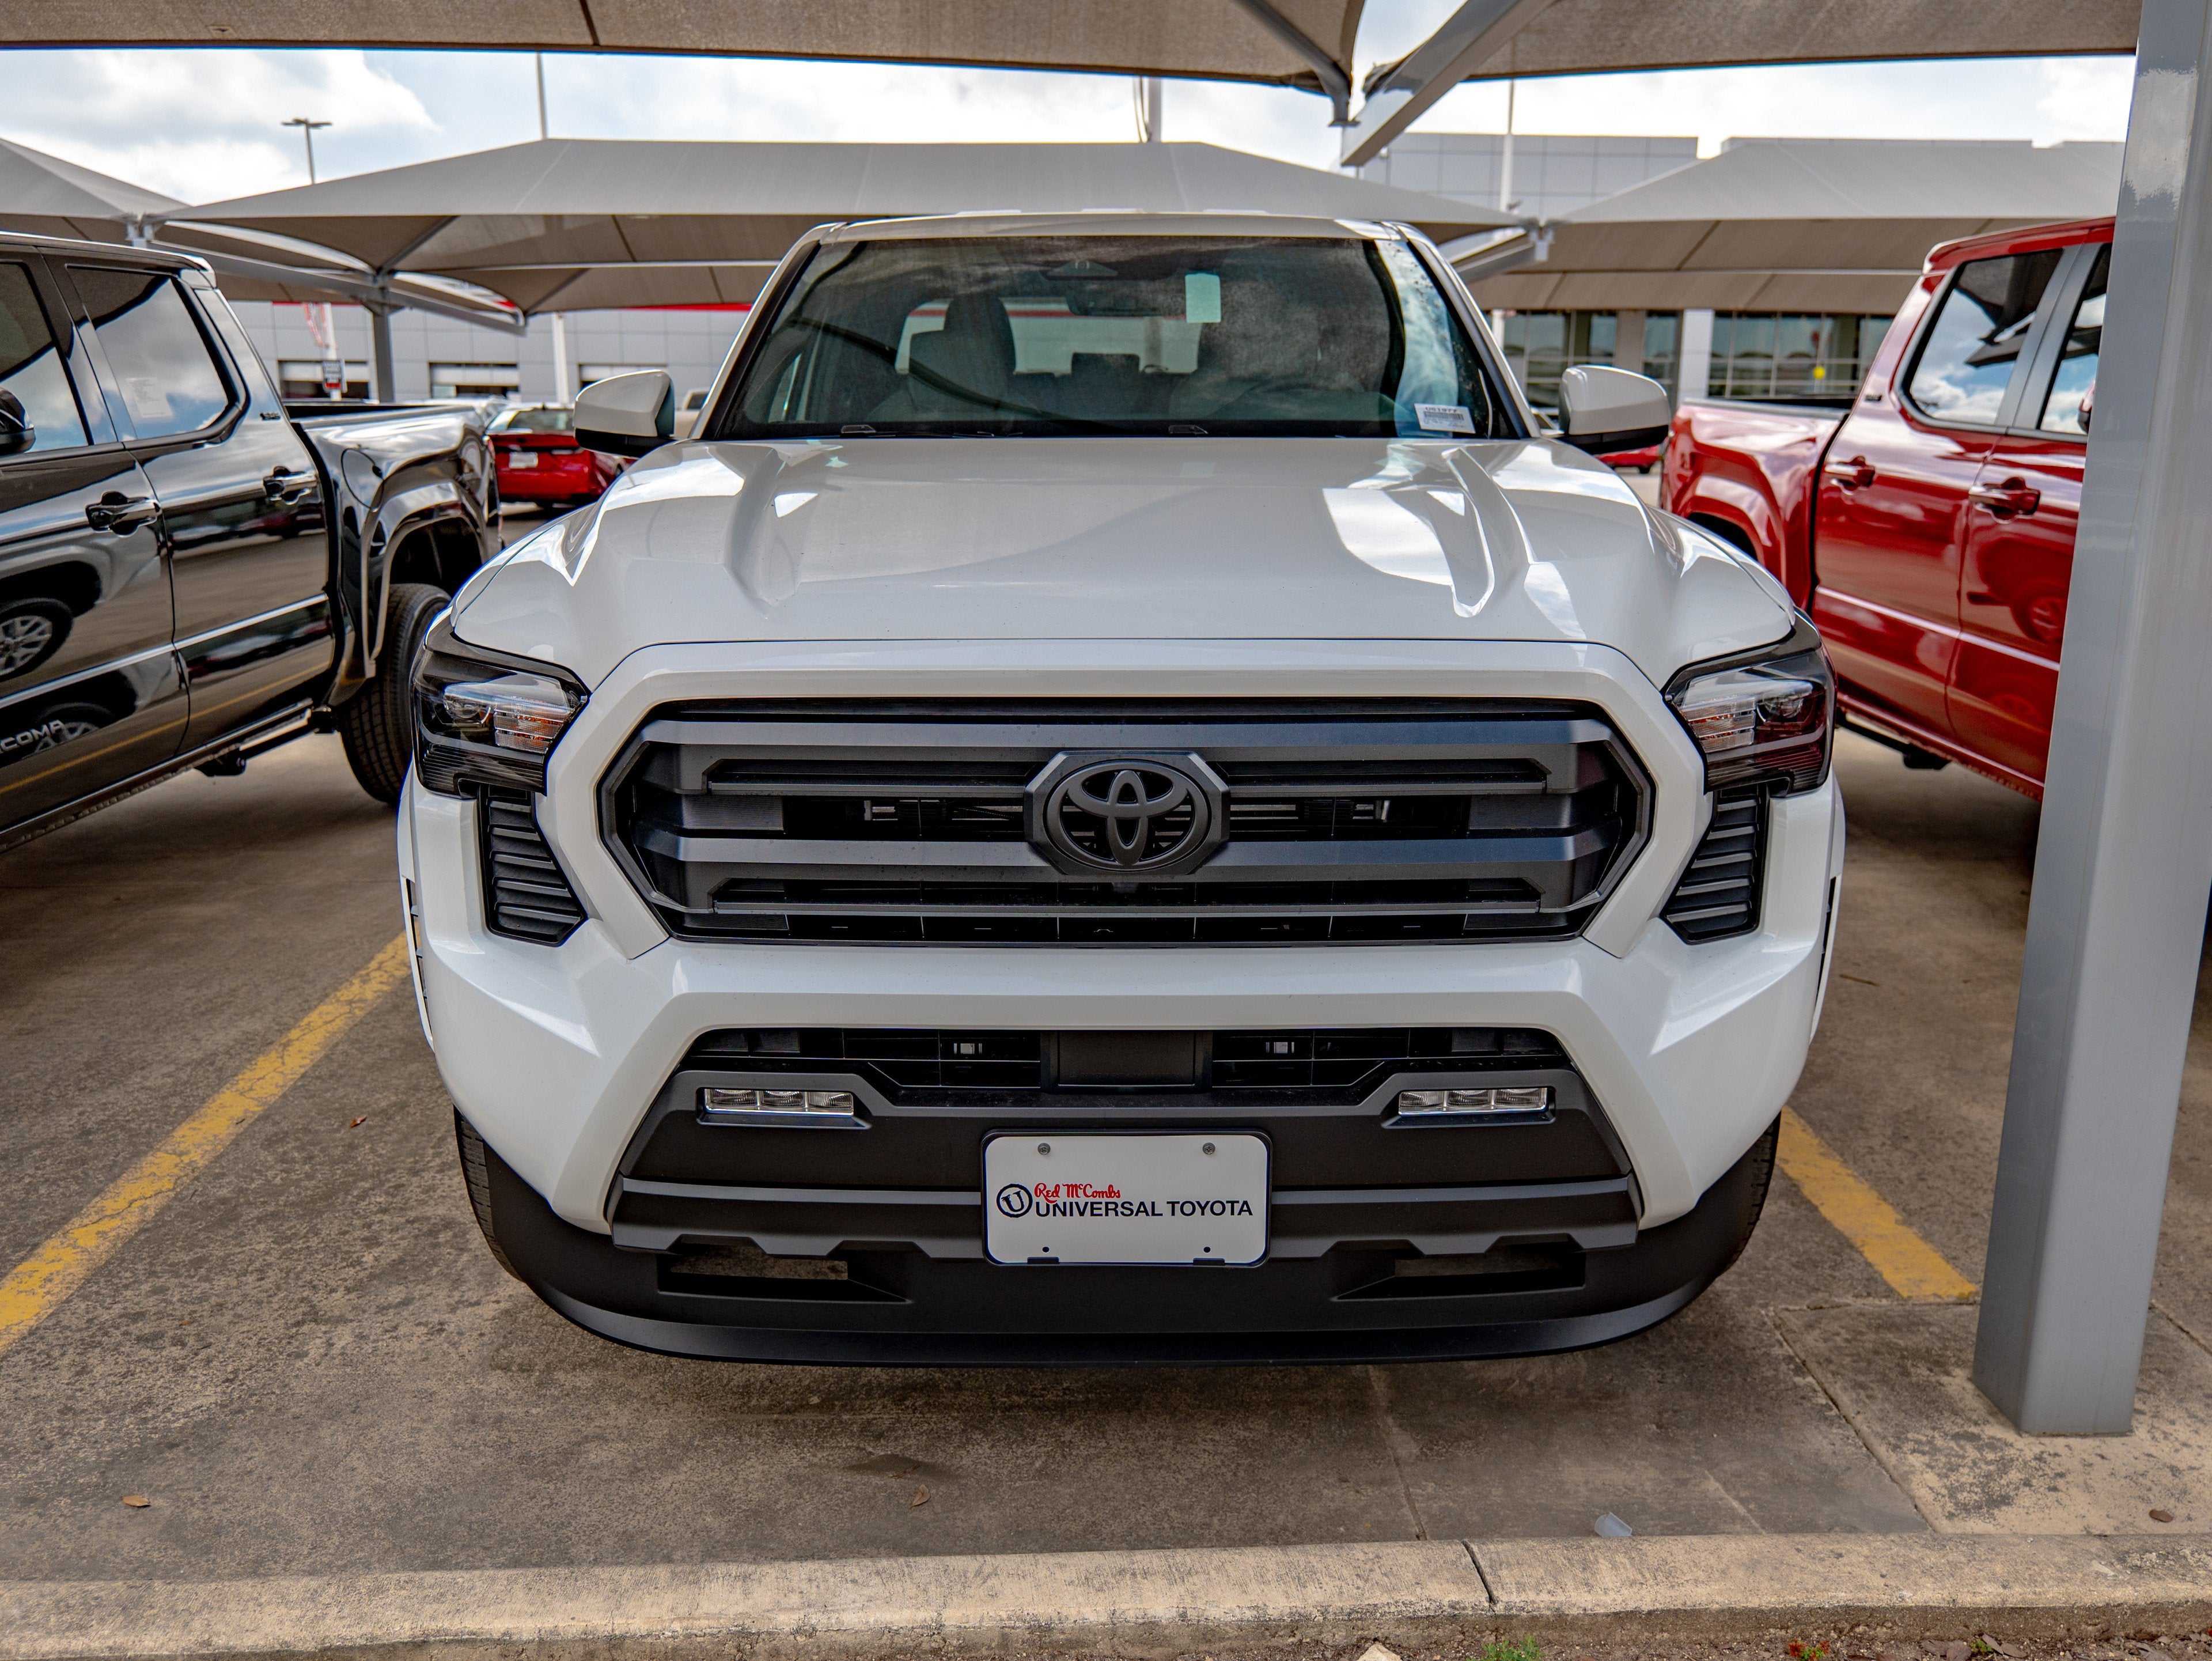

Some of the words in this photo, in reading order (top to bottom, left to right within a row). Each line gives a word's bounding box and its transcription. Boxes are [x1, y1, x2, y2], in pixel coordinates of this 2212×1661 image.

[0, 719, 65, 754] COMA
[1001, 1190, 1025, 1212] U
[1034, 1183, 1060, 1204] Red
[1062, 1183, 1121, 1198] McCombs
[1036, 1201, 1162, 1217] UNIVERSAL
[1166, 1200, 1253, 1216] TOYOTA
